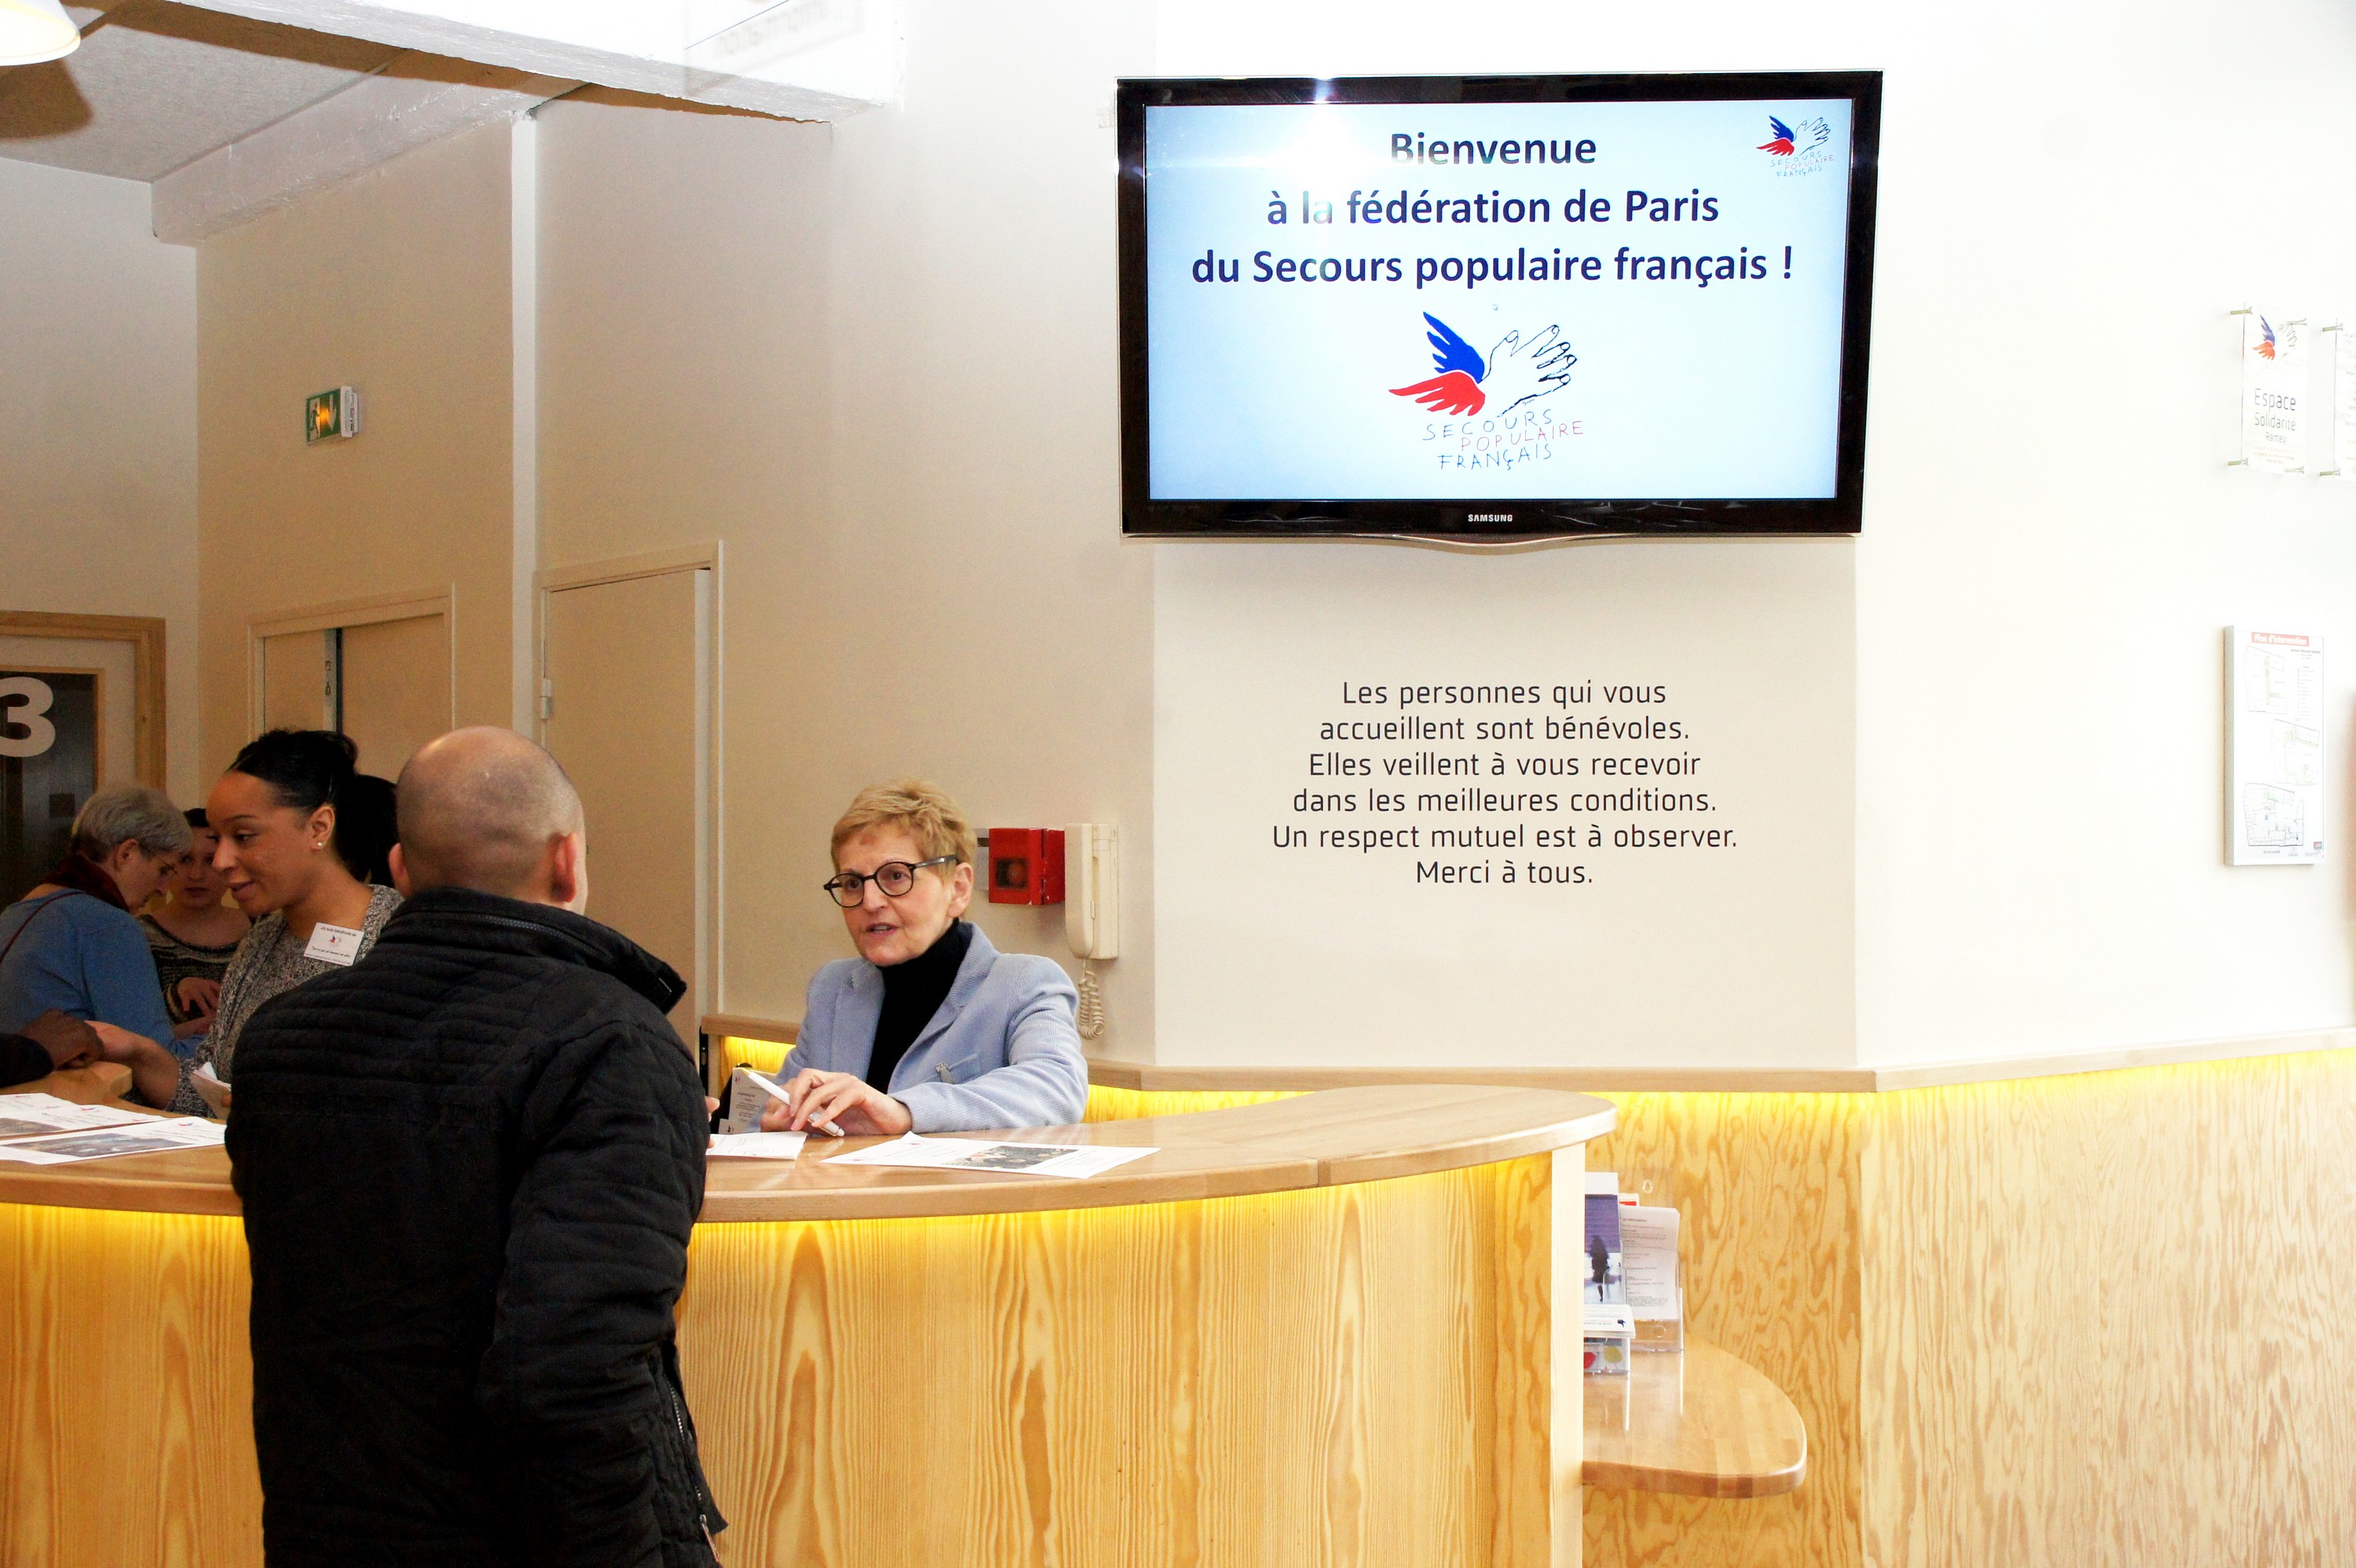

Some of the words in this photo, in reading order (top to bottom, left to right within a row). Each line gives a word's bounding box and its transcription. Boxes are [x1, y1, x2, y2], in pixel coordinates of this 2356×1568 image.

[1391, 131, 1597, 165] Bienvenue
[1769, 151, 1821, 167] SECOURS
[1784, 155, 1834, 170] POPULAIRE
[1268, 190, 1287, 225] à
[1302, 190, 1333, 225] la
[1347, 189, 1550, 224] fédération
[1564, 188, 1611, 223] de
[1626, 188, 1719, 222] Paris
[1192, 249, 1239, 283] du
[1253, 250, 1403, 283] Secours
[1416, 247, 1602, 290] populaire
[1614, 246, 1767, 288] français
[1783, 245, 1792, 280] !
[2254, 388, 2296, 411] Espace
[1422, 409, 1552, 440] SECOURS
[2254, 412, 2296, 431] Solidarité
[1461, 421, 1584, 451] POPULAIRE
[1437, 444, 1552, 470] FRANÇAIS
[1468, 514, 1513, 522] SAMSUNG
[2254, 633, 2267, 643] Plan
[1344, 682, 1387, 704] Les
[1401, 686, 1540, 709] personnes
[1553, 680, 1590, 709] qui
[1604, 685, 1666, 704] vous
[0, 677, 56, 758] 3
[1321, 716, 1465, 740] accueillent
[1477, 718, 1534, 740] sont
[1546, 716, 1688, 740] bénévoles.
[1310, 752, 1371, 776] Elles
[1383, 752, 1480, 776] veillent
[1491, 751, 1505, 776] à
[1516, 758, 1579, 776] vous
[1593, 751, 1700, 776] recevoir
[1293, 788, 1356, 812] dans
[1369, 788, 1406, 812] les
[1418, 788, 1558, 812] meilleures
[1571, 788, 1716, 812] conditions.
[1274, 825, 1307, 848] Un
[1320, 826, 1420, 853] respect
[1432, 824, 1524, 848] mutuel
[1536, 826, 1577, 848] est
[1588, 824, 1601, 848] à
[1614, 824, 1736, 848] observer.
[1417, 860, 1489, 884] Merci
[1502, 860, 1516, 884] à
[1527, 862, 1592, 884] tous.
